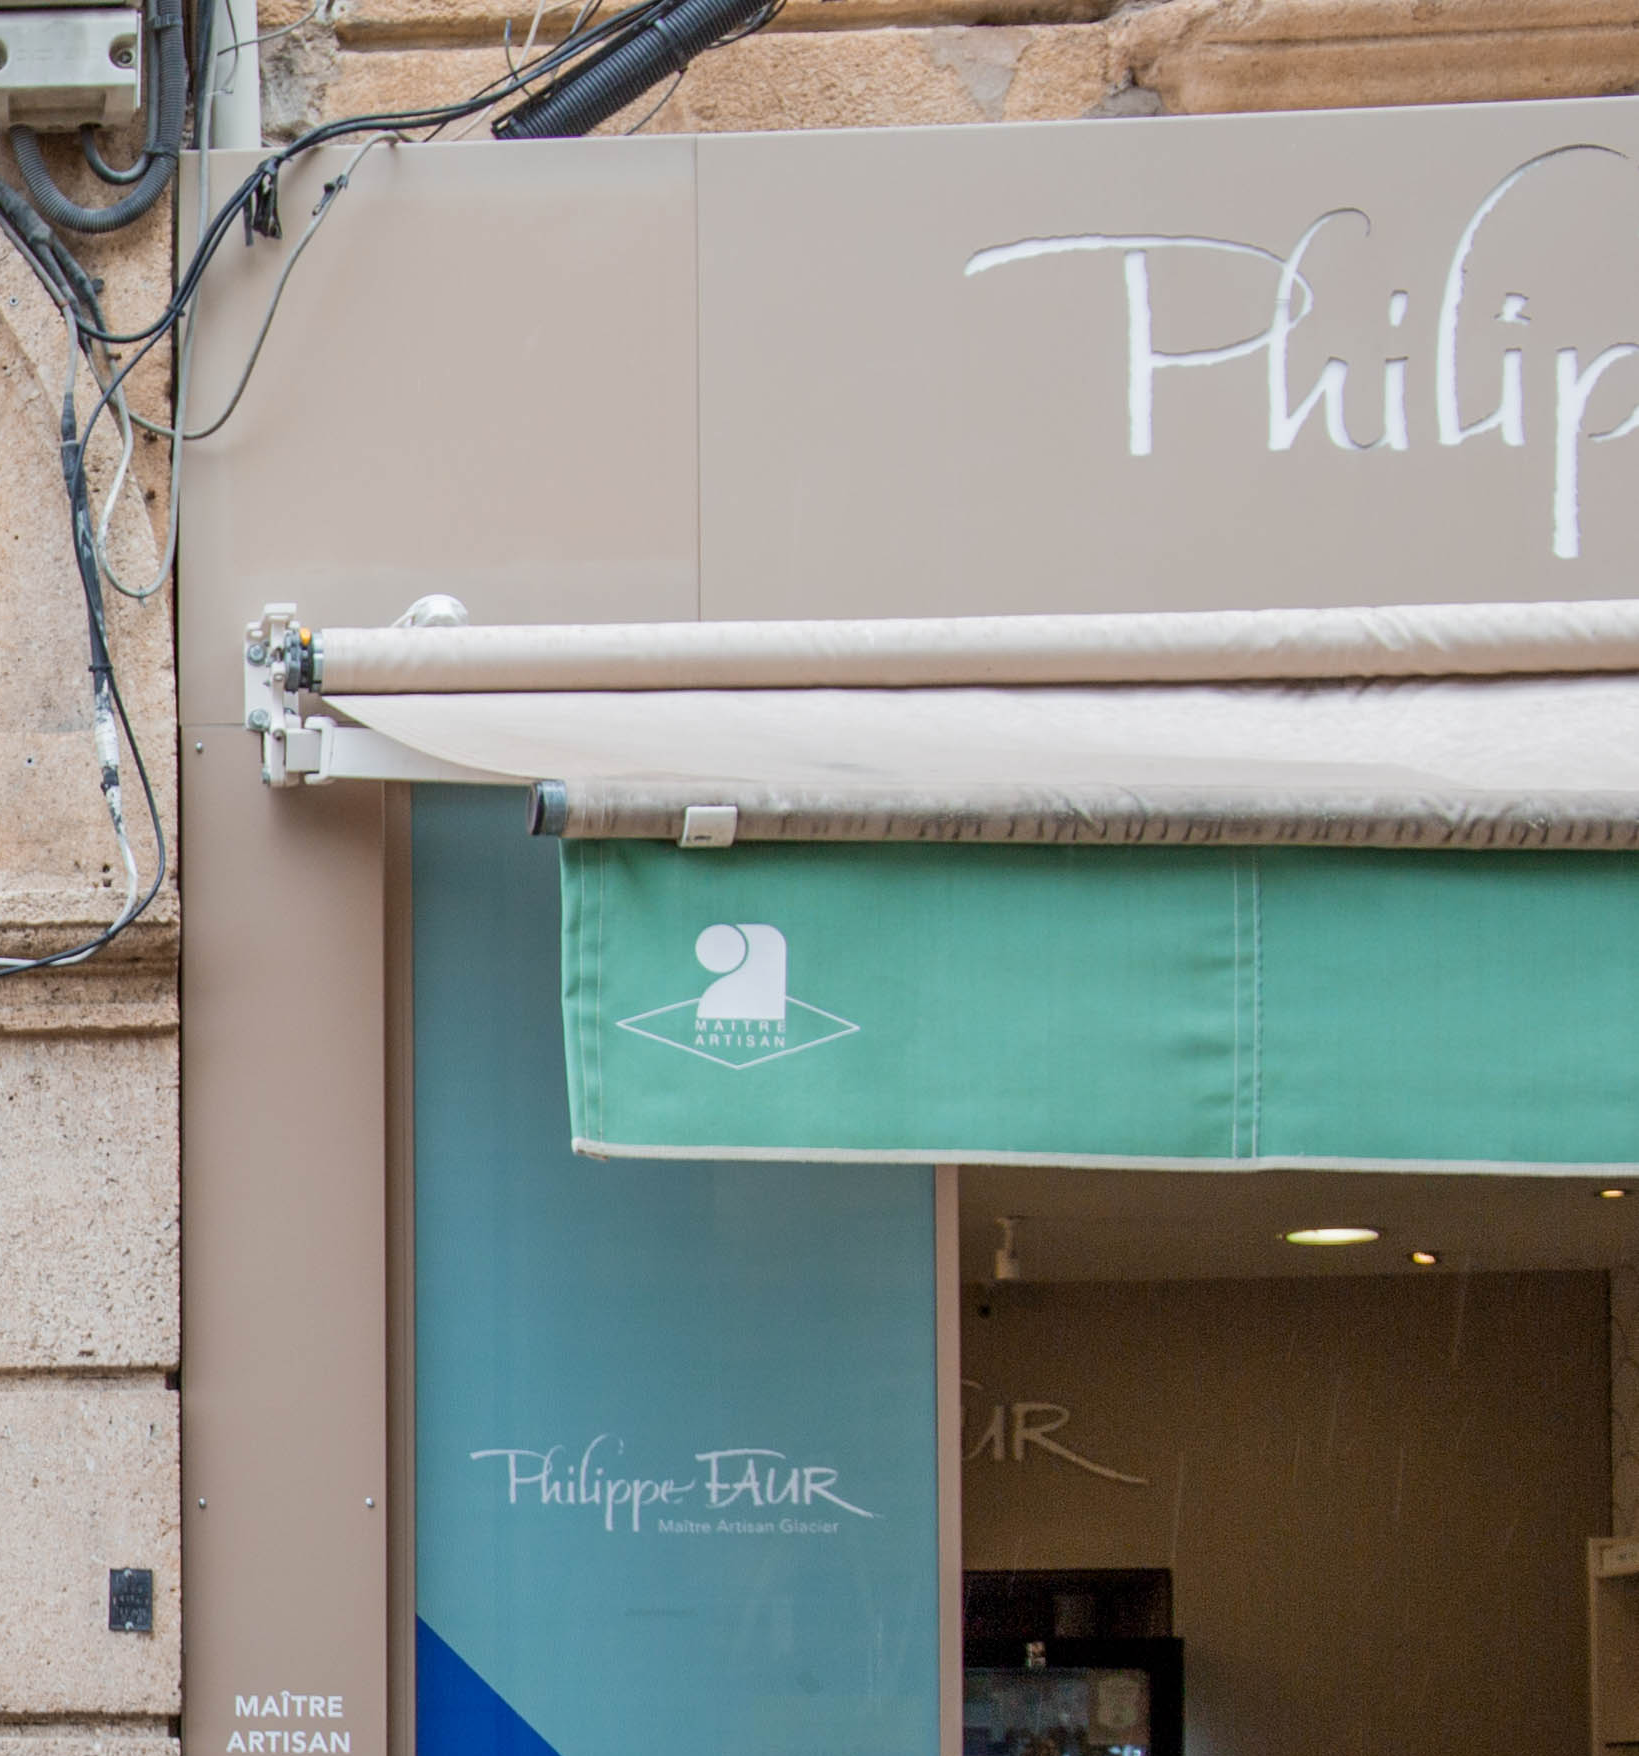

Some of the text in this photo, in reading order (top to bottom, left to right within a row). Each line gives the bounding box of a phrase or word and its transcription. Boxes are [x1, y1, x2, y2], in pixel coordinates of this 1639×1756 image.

[695, 1034, 786, 1048] ARTISAN
[470, 1433, 884, 1532] Philippe FAUR
[716, 1518, 774, 1534] Artisan
[779, 1518, 839, 1534] Glacier
[235, 1689, 344, 1718] MAÎTRE
[226, 1730, 352, 1754] ARTISAN
